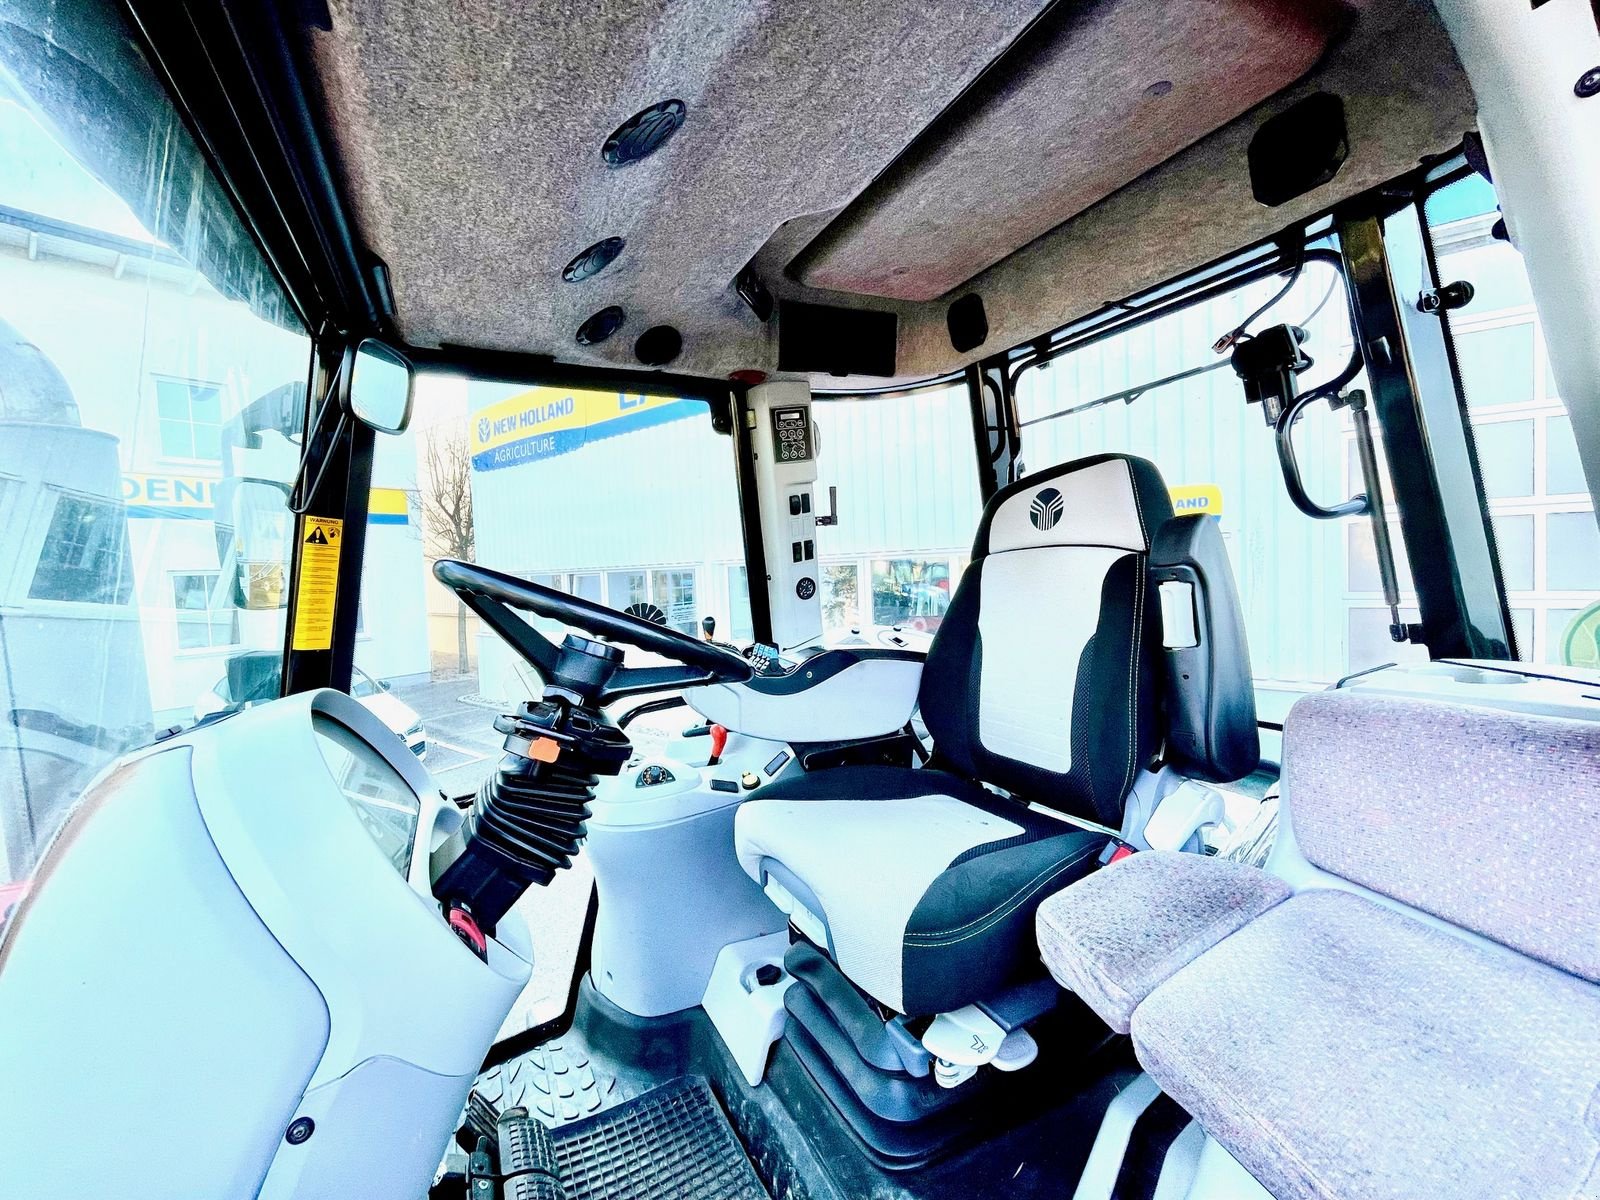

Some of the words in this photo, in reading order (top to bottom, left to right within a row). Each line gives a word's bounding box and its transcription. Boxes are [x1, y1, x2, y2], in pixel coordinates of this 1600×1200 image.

[494, 414, 517, 436] NEW
[519, 397, 574, 428] HOLLAND
[494, 436, 555, 463] AGRICULTURE
[1176, 497, 1208, 509] AND
